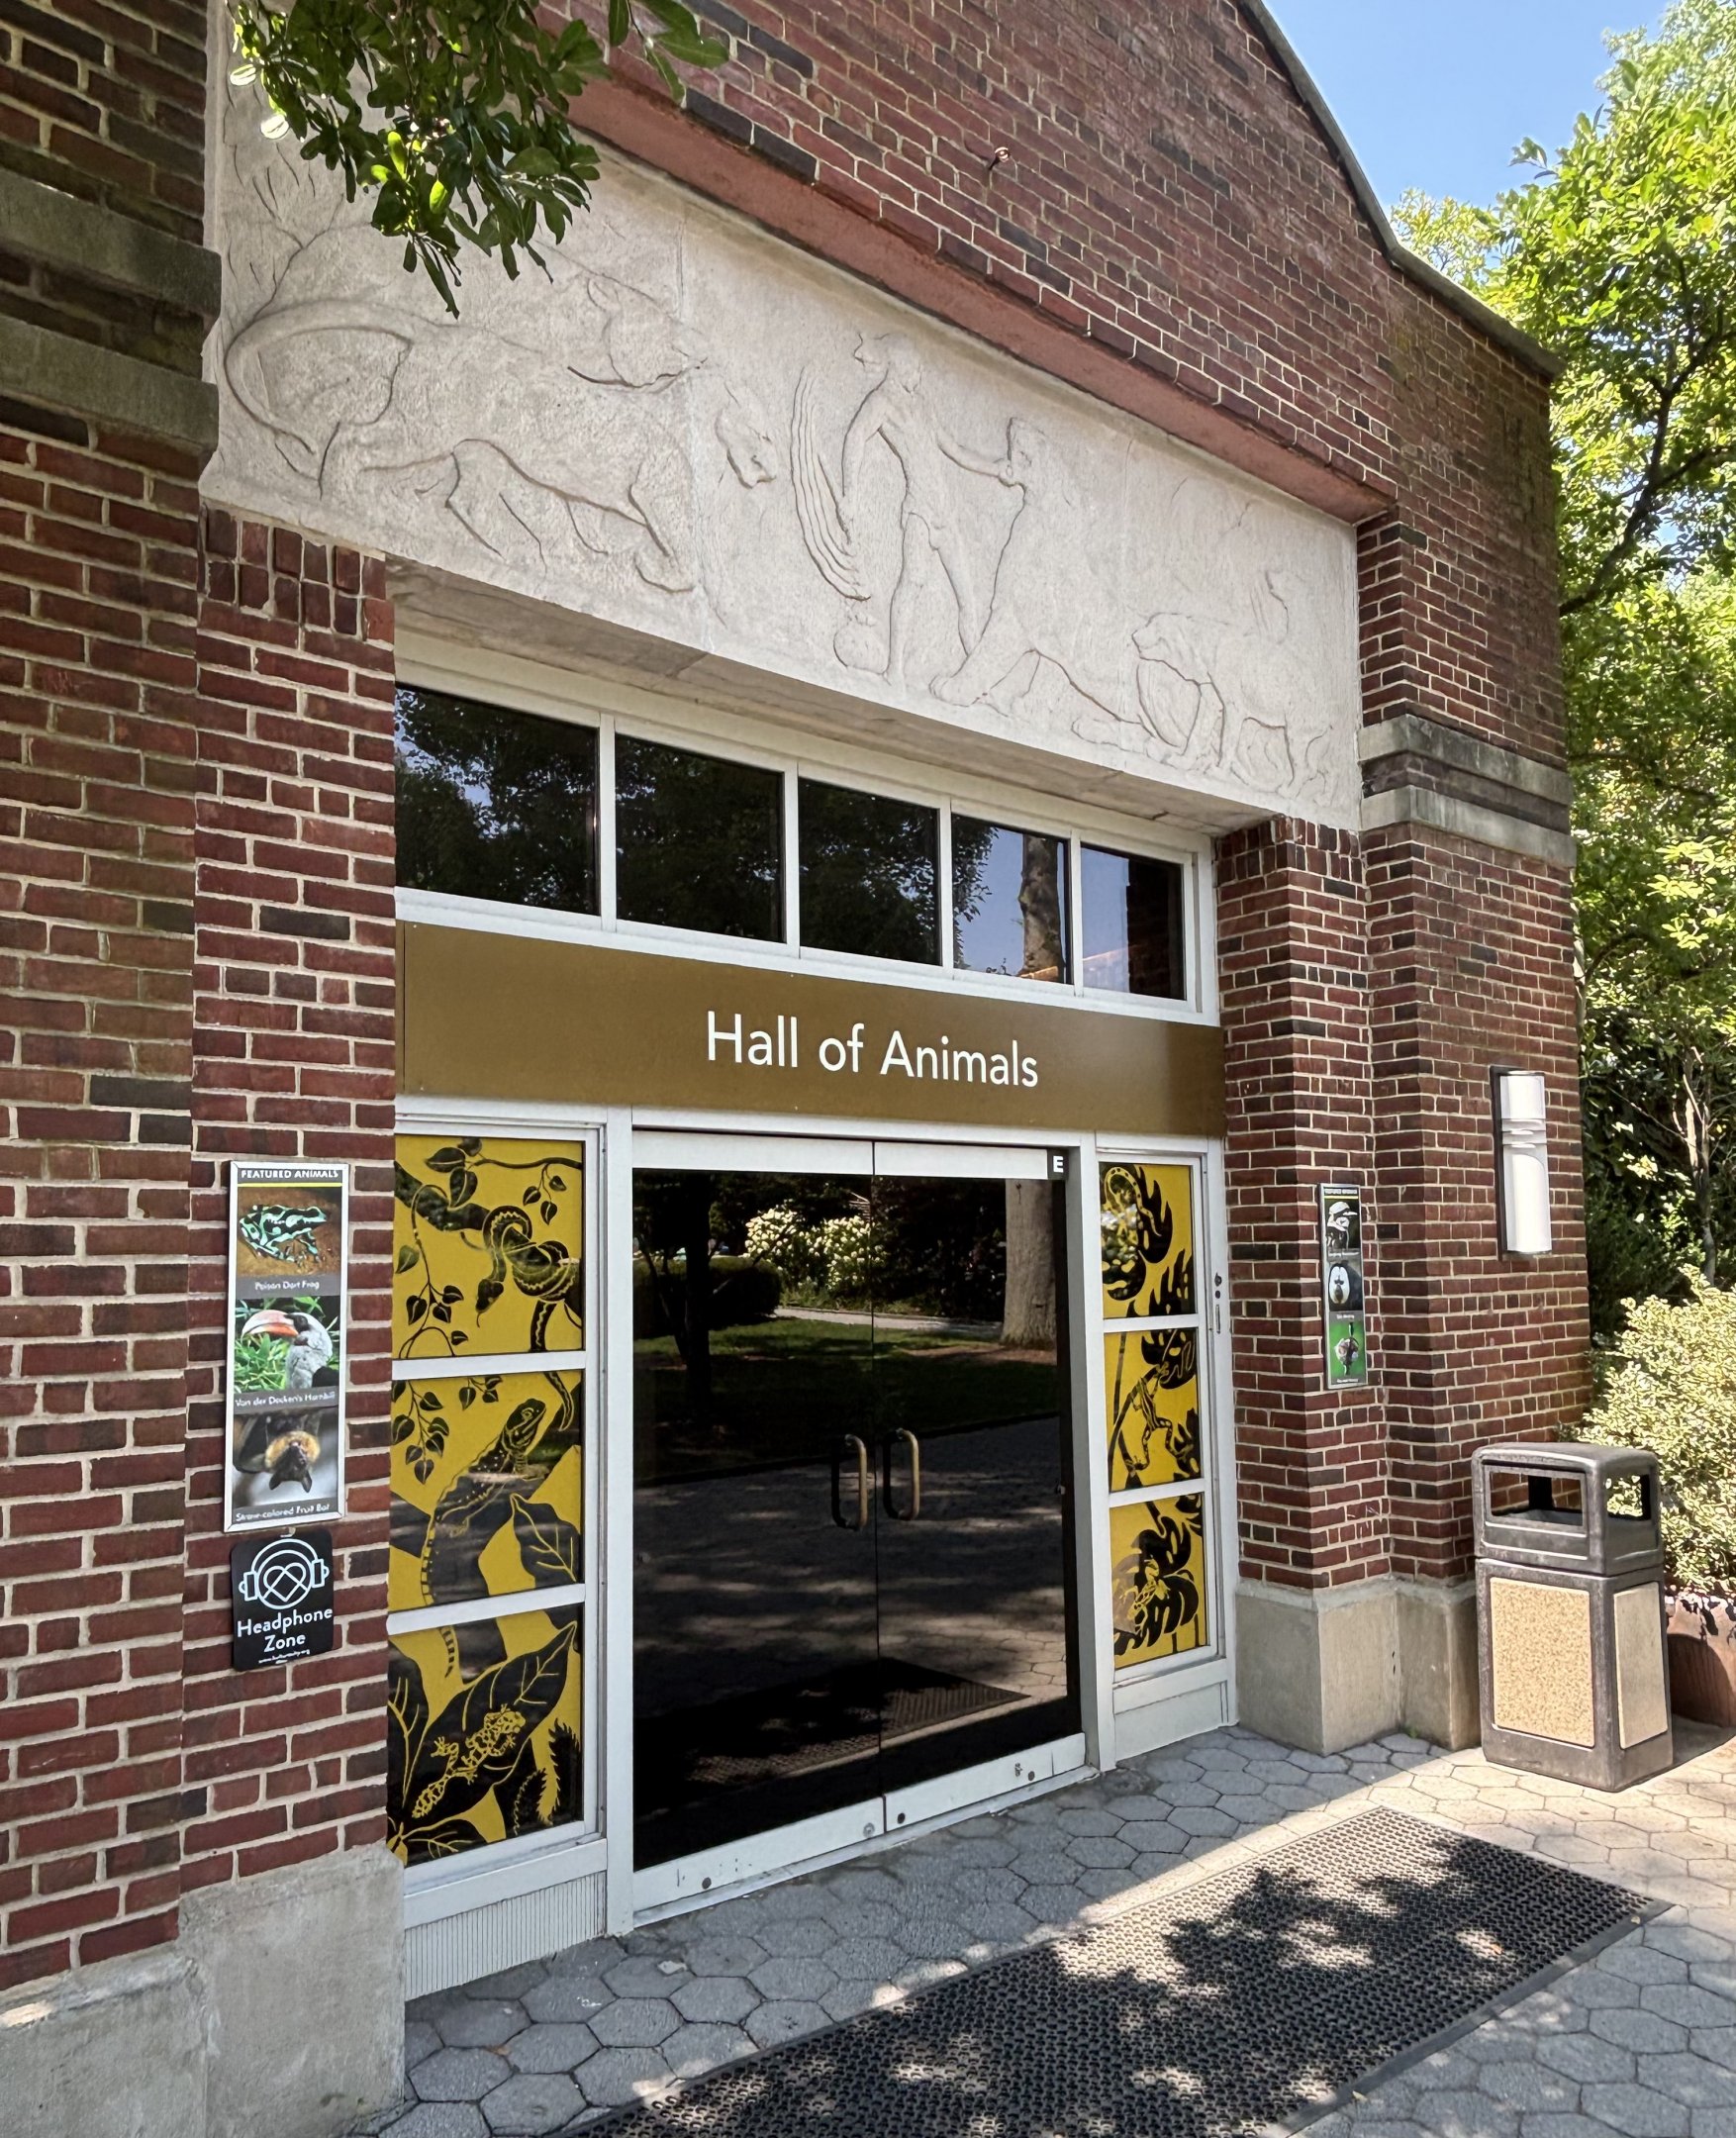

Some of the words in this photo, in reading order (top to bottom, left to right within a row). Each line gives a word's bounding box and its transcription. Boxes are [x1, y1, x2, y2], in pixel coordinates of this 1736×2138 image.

[707, 1011, 798, 1068] Hall
[819, 1022, 865, 1073] of
[880, 1030, 1038, 1088] Animals
[1053, 1155, 1064, 1173] E
[241, 1169, 292, 1179] FEATURED
[294, 1169, 338, 1179] ANIMALS
[254, 1281, 281, 1290] Poison
[282, 1280, 301, 1290] Dart
[302, 1280, 320, 1290] Frog
[238, 1608, 333, 1637] Headphone
[263, 1634, 306, 1653] Zone
